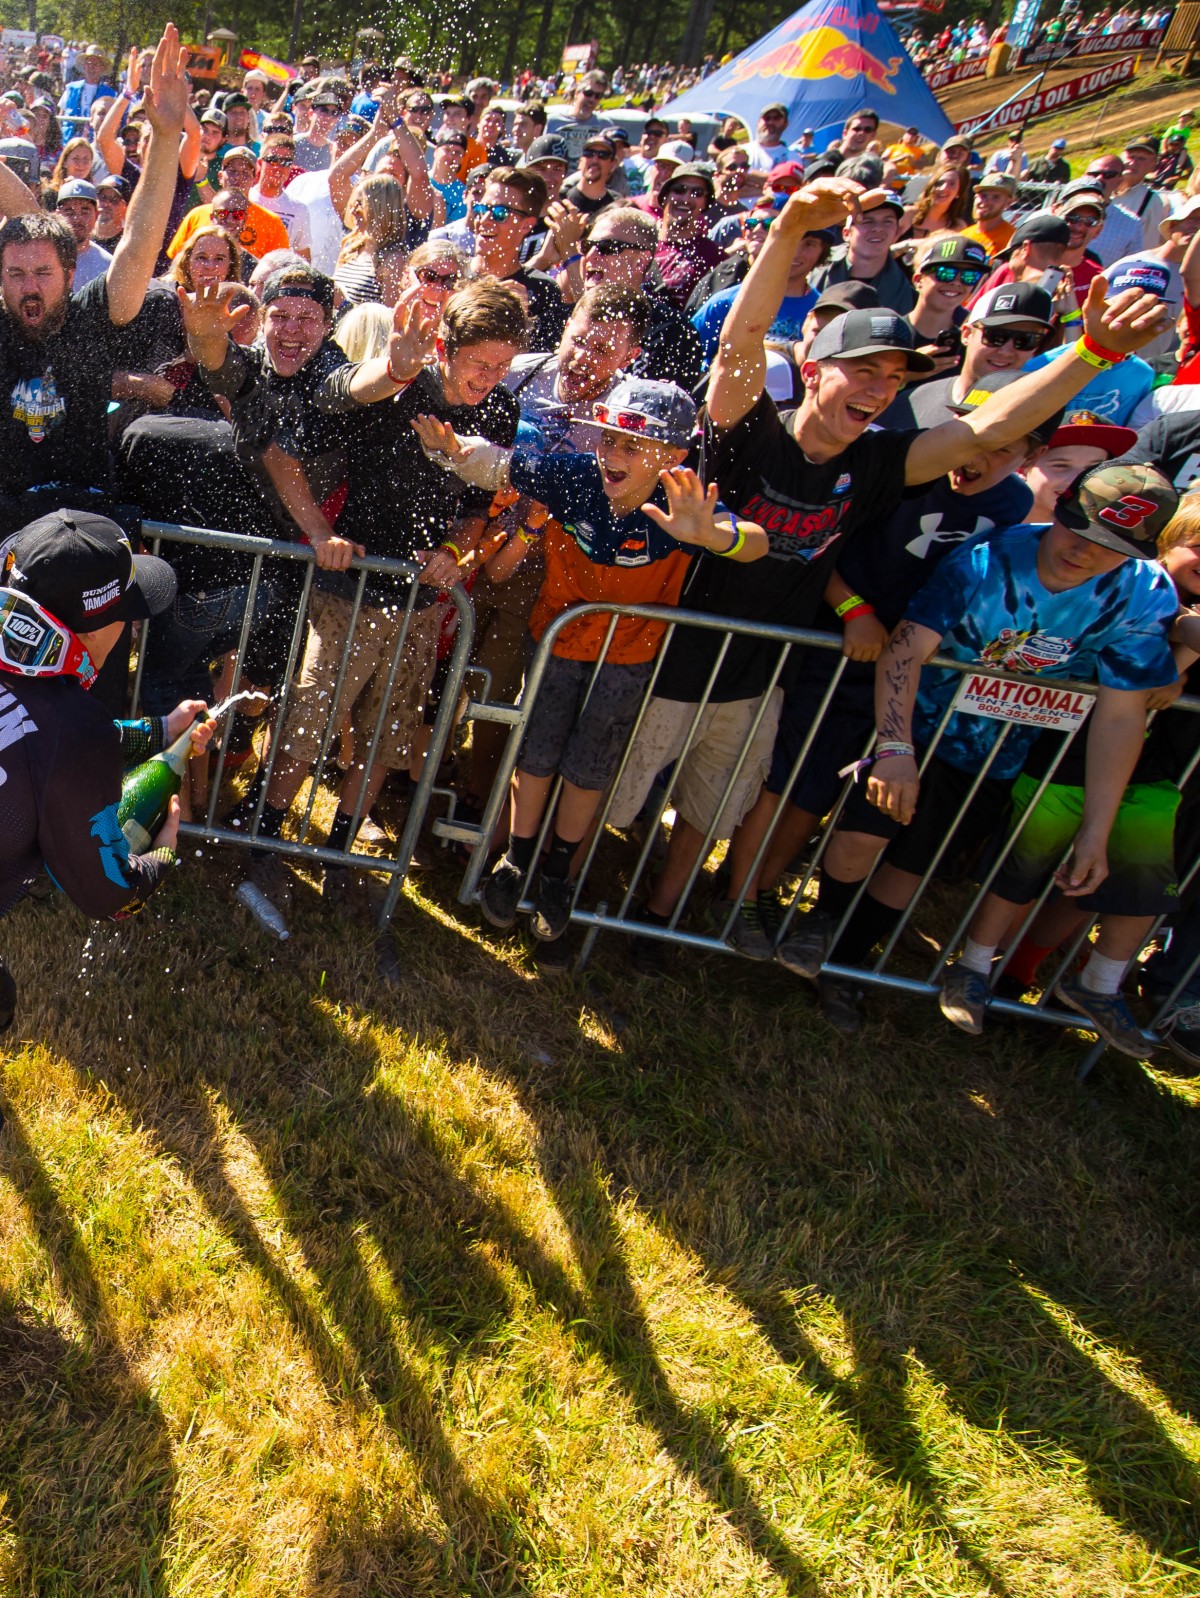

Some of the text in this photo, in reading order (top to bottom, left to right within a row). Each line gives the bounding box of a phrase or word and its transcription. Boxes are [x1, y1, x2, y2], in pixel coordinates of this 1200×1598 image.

[830, 6, 880, 34] Bull
[1078, 35, 1120, 55] LUCAS
[1121, 32, 1143, 48] OIL
[931, 60, 987, 88] OIL LUCA
[990, 96, 1042, 131] LUCAS
[1044, 84, 1071, 108] OIL
[1079, 62, 1133, 94] LUCAS
[742, 495, 818, 538] LUCAS
[1099, 495, 1159, 529] 3
[81, 579, 120, 598] DUNLOP
[82, 586, 121, 612] YAMALUBE
[9, 617, 40, 641] 100%
[964, 694, 1083, 720] RENT-A-FENCE
[966, 676, 1085, 715] NATIONAL
[978, 704, 1060, 724] 800-352-5675
